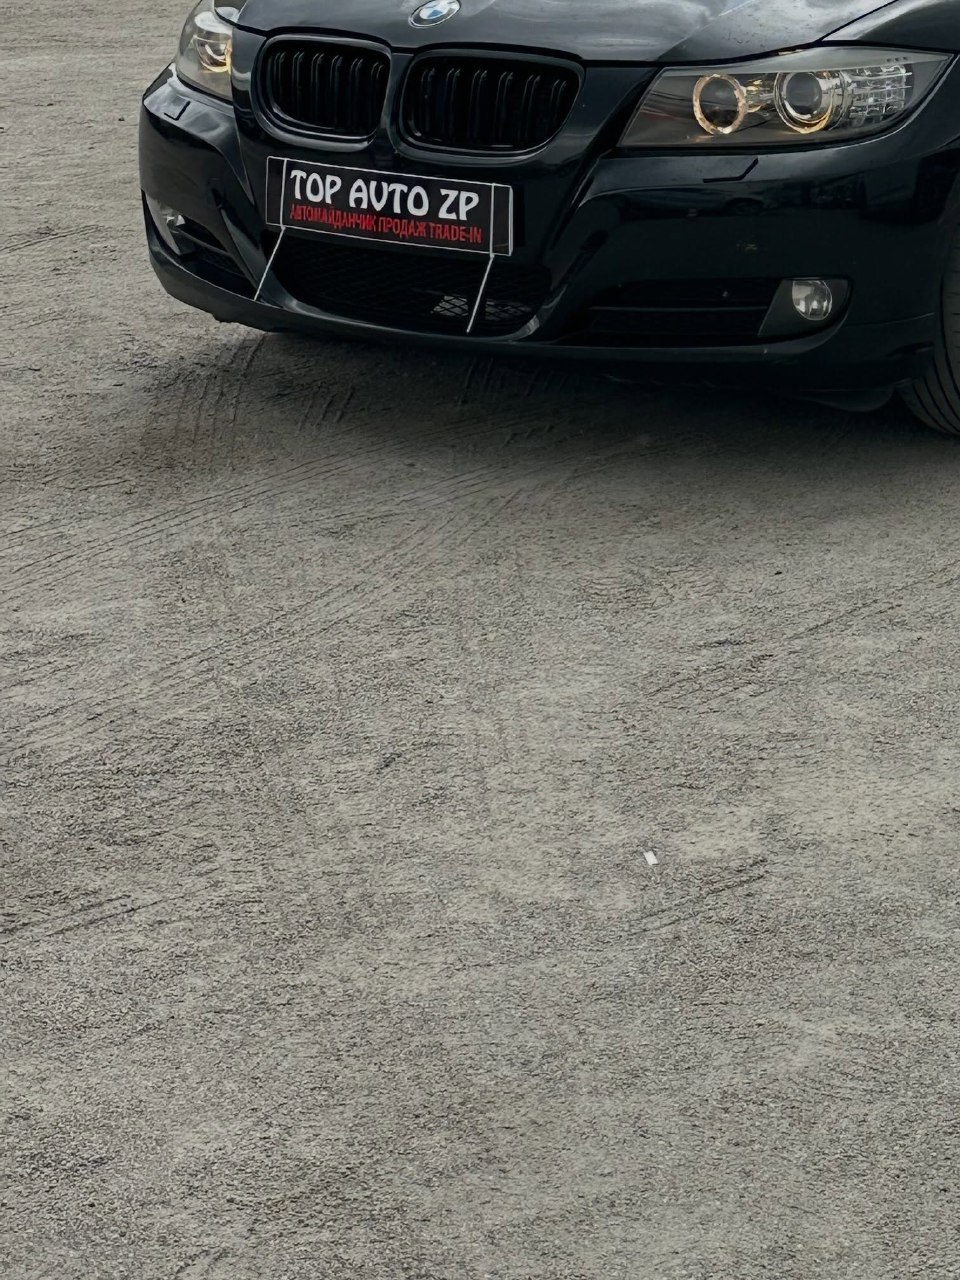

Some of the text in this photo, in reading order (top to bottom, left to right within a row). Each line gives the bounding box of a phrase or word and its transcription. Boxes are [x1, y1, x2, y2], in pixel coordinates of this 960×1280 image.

[290, 170, 342, 204] TOP
[438, 188, 479, 220] ZP
[289, 203, 482, 244] АВТОМАЙДАНЧИК ПРОДАЖ TRADE-IN
